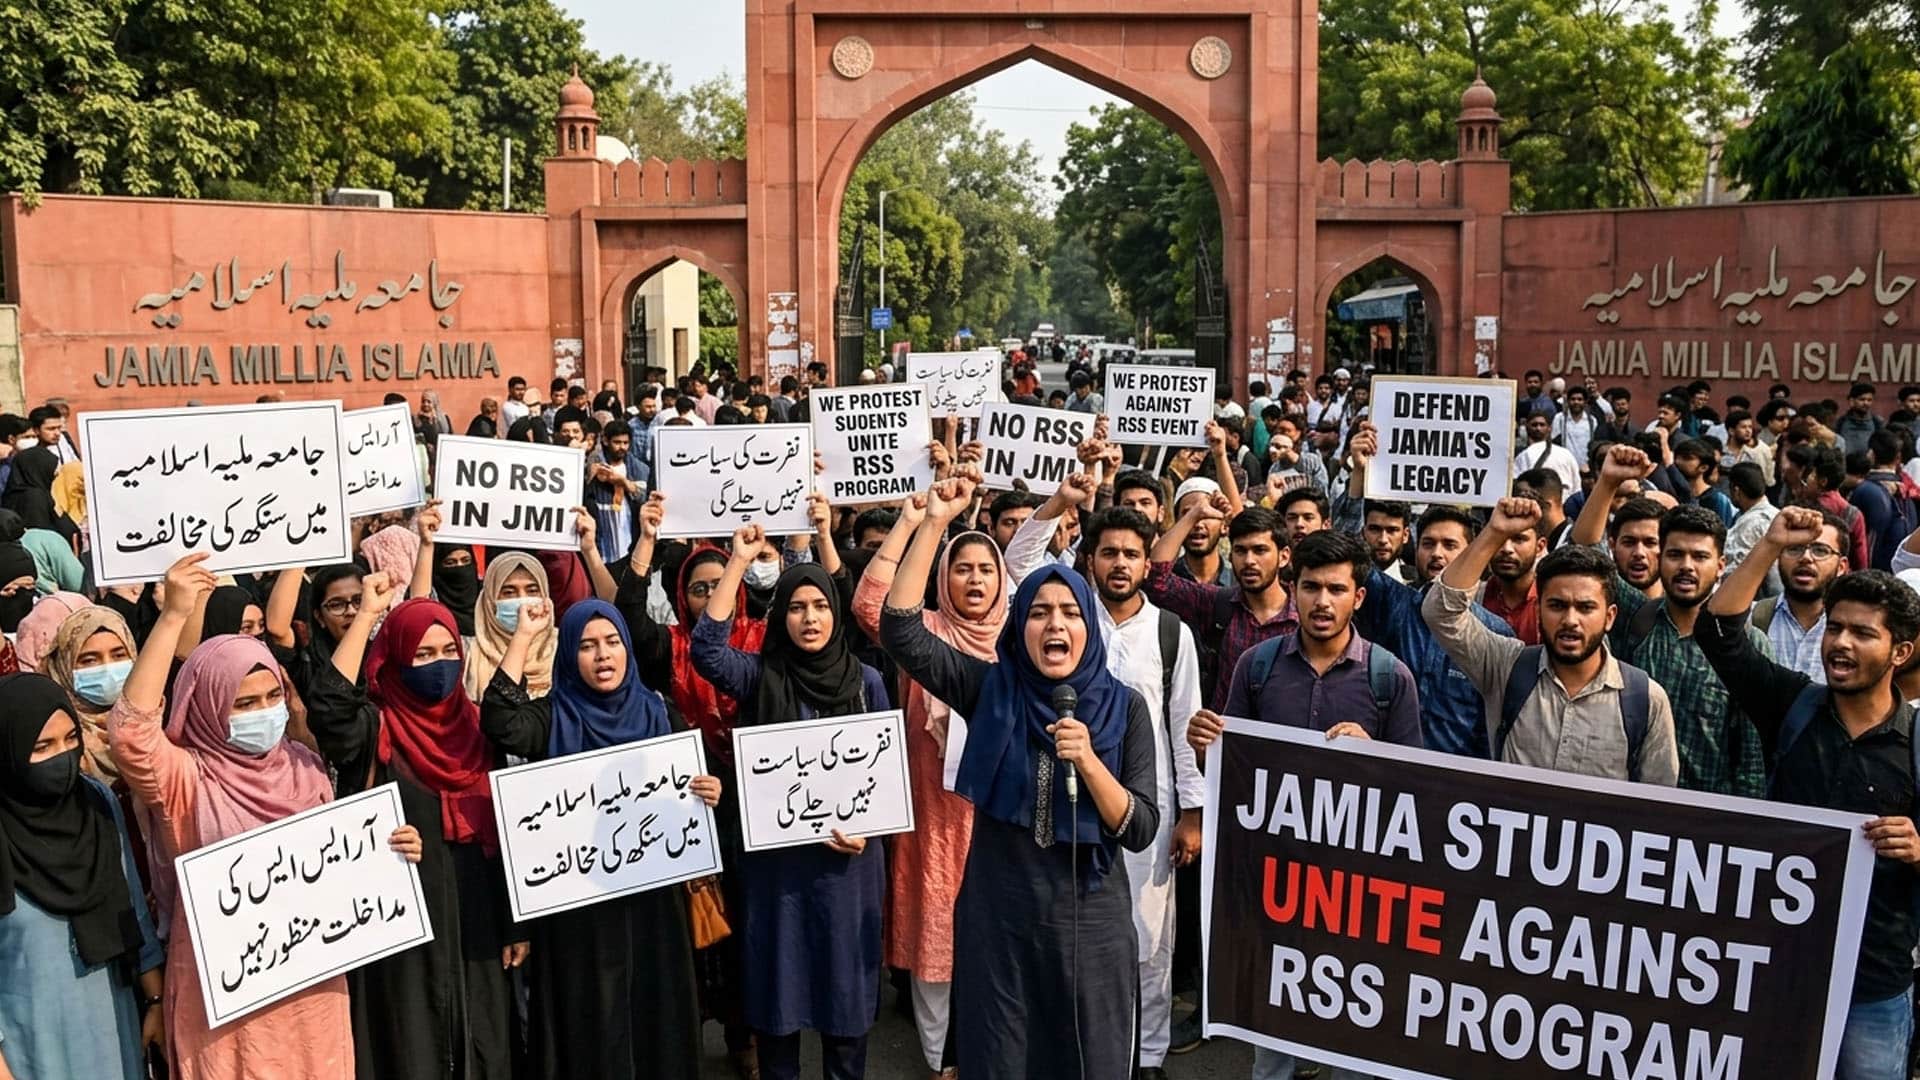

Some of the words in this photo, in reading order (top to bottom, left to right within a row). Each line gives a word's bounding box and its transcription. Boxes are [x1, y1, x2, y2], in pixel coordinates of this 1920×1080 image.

[132, 256, 291, 328] اسلامیہ
[289, 249, 358, 328] ملیہ
[355, 258, 464, 328] جامعہ
[1581, 255, 1723, 324] اسلامیہ
[1720, 245, 1789, 325] ملیہ
[1788, 249, 1917, 326] جامعہ
[94, 345, 219, 388] JAMIA
[230, 343, 352, 385] MILLIA
[362, 341, 500, 382] ISLAMIA
[1549, 340, 1649, 376] JAMIA
[1662, 340, 1780, 380] MILLIA
[819, 395, 845, 412] WE
[849, 390, 921, 410] PROTEST
[1113, 372, 1136, 389] WE
[1140, 374, 1208, 392] PROTEST
[835, 412, 908, 432] SUDENTS
[1125, 395, 1192, 414] AGAINST
[1394, 391, 1490, 422] DEFEND
[847, 433, 899, 452] UNITE
[989, 411, 1025, 440] NO
[1033, 416, 1084, 447] RSS
[1117, 416, 1147, 433] RSS
[1151, 418, 1199, 436] EVENT
[1388, 428, 1491, 459] JAMIA'S
[210, 434, 252, 481] ملیہ
[256, 435, 324, 476] جامعہ
[670, 446, 731, 474] سیاست
[734, 434, 756, 469] کی
[753, 436, 800, 473] نفرت
[853, 454, 894, 476] RSS
[984, 448, 1015, 476] IN
[456, 458, 499, 489] NO
[509, 463, 565, 494] RSS
[765, 479, 804, 515] نہیں
[834, 476, 916, 497] PROGRAM
[1390, 464, 1488, 496] LEGACY
[451, 500, 489, 528] IN
[501, 504, 564, 533] JMI
[711, 478, 735, 517] گی
[116, 512, 207, 552] مخالفت
[210, 497, 243, 551] کی
[239, 493, 287, 545] سنگھ
[287, 502, 327, 545] میں
[752, 746, 817, 777] سیاست
[821, 729, 843, 770] کی
[842, 727, 892, 769] نفرت
[597, 771, 631, 814] ملیہ
[634, 763, 691, 802] جامعہ
[836, 777, 877, 820] نہیں
[777, 782, 801, 829] گی
[798, 789, 832, 833] چلے
[602, 822, 626, 873] کی
[626, 813, 664, 864] سنگھ
[665, 817, 701, 859] میں
[1235, 767, 1423, 862] JAMIA
[1443, 802, 1817, 926] STUDENTS
[218, 853, 244, 916] کی
[524, 845, 599, 887] مخالفت
[322, 895, 406, 944] مداخلت
[1262, 855, 1445, 955] UNITE
[1459, 898, 1771, 1012] AGAINST
[221, 922, 269, 992] نہیں
[266, 917, 320, 969] منظور
[1269, 944, 1384, 1028] RSS
[1404, 973, 1743, 1080] PROGRAM
